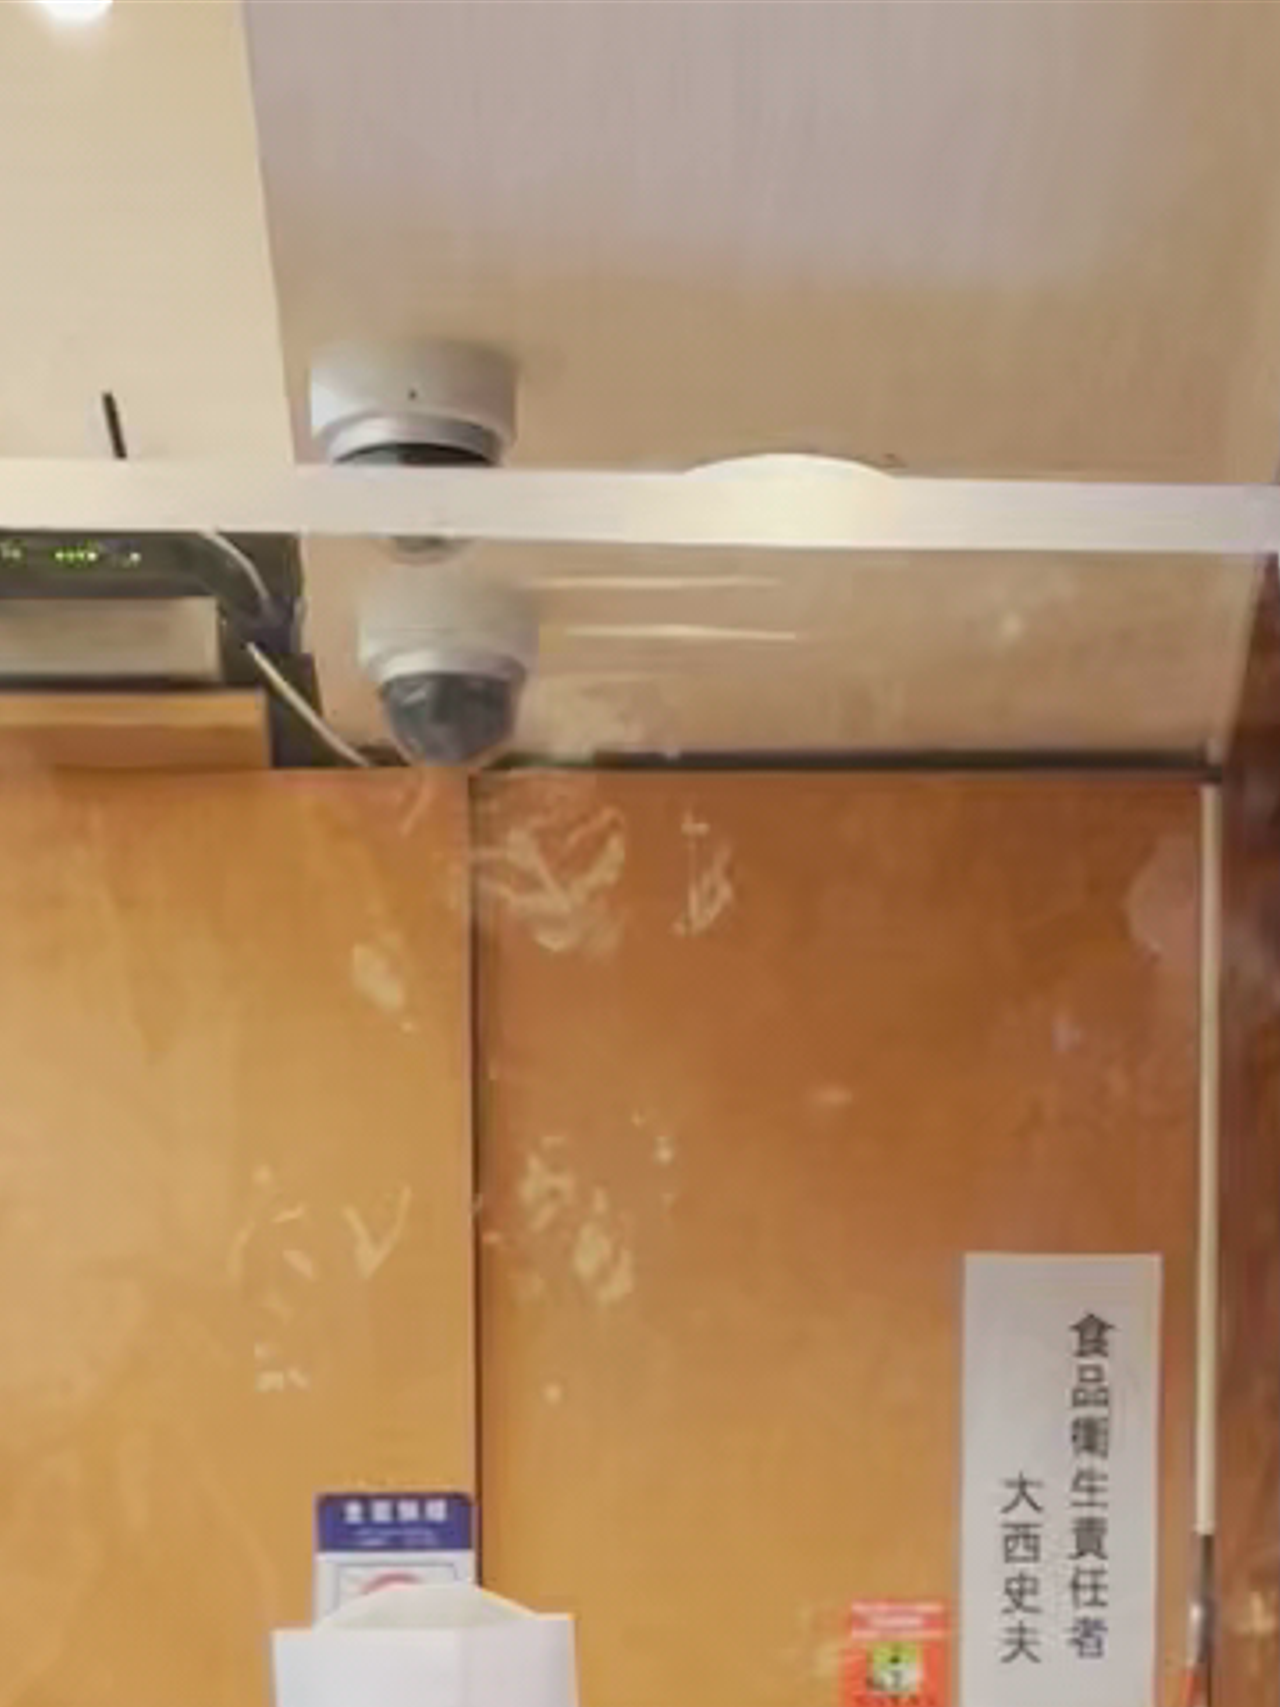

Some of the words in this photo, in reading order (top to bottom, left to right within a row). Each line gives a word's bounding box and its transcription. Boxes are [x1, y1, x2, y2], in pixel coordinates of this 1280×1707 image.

[999, 1470, 1044, 1665] 大西史夫
[1068, 1312, 1114, 1661] 食品衛生責任者
